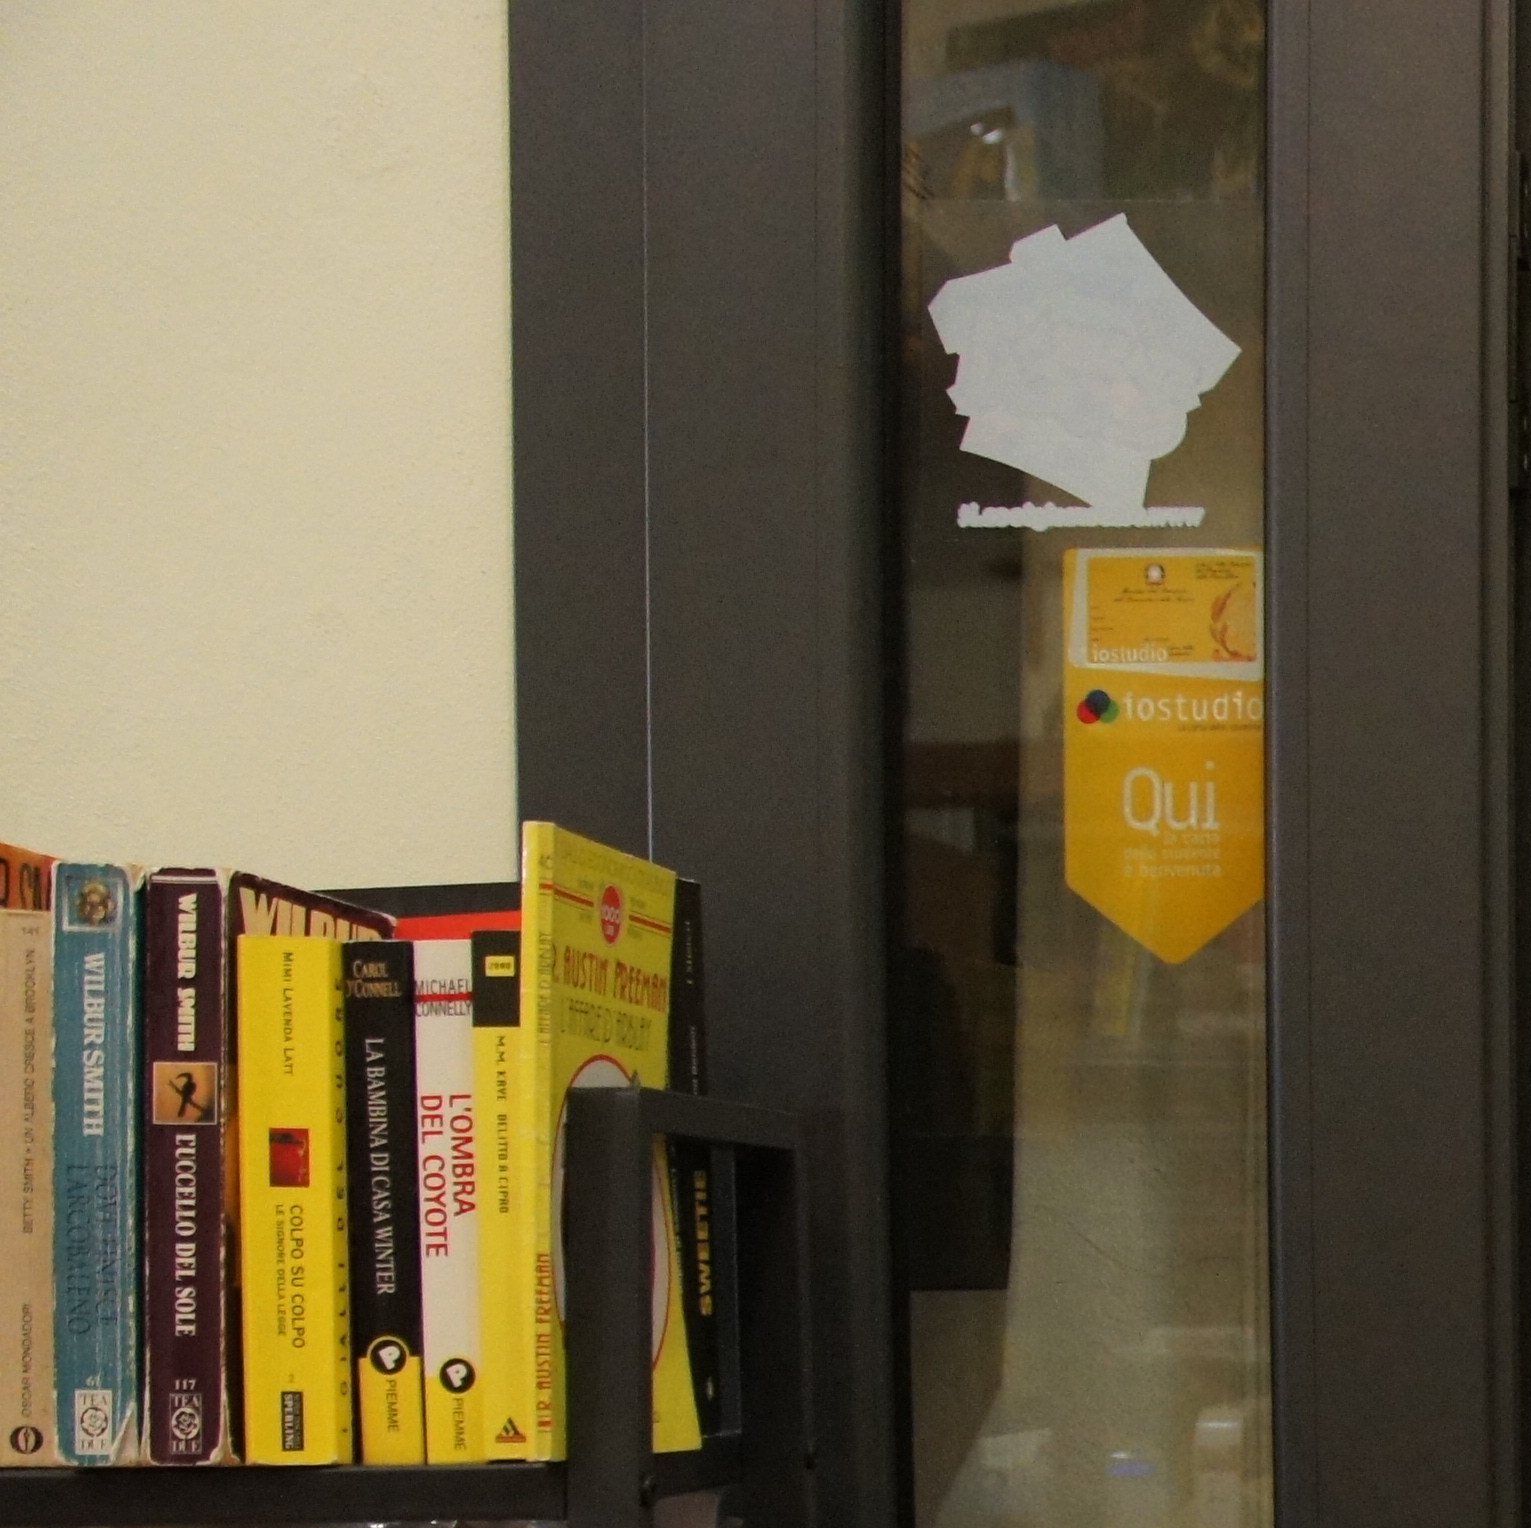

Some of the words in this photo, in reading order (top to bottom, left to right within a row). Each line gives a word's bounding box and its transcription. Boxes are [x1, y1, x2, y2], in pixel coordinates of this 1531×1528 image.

[1123, 691, 1264, 721] iostudio
[1124, 761, 1220, 836] Qui
[177, 892, 198, 980] WILBUR
[23, 949, 37, 1014] BROOKLYN
[281, 951, 295, 984] MIMI
[353, 959, 388, 979] CAROL
[414, 977, 471, 996] MICHAEL
[563, 944, 609, 997] AUSTIN
[613, 958, 668, 1014] FREEMAN
[83, 951, 105, 1045] WILBUR
[176, 986, 197, 1052] SMITH
[281, 987, 295, 1043] LAVENDA
[414, 1000, 472, 1017] CONNELLY
[23, 1029, 36, 1076] CRESCE
[282, 1046, 295, 1076] LATT
[364, 1037, 385, 1063] LA
[82, 1048, 105, 1136] SMITH
[366, 1066, 391, 1149] BAMBINA
[420, 1094, 444, 1145] DEL
[496, 1113, 509, 1162] DELITTO
[23, 1158, 36, 1194] SMITH
[370, 1152, 390, 1172] DI
[448, 1093, 477, 1218] L'OMBRA
[23, 1198, 36, 1235] BETTY
[371, 1174, 392, 1224] CASA
[422, 1154, 449, 1258] COYOTE
[498, 1176, 509, 1214] CIPRO
[289, 1203, 305, 1260] COLPO
[692, 1169, 714, 1317] SWEETIE
[174, 1243, 197, 1282] DEL
[276, 1269, 287, 1299] DELLA
[290, 1263, 305, 1289] SU
[373, 1225, 396, 1295] WINTER
[174, 1286, 197, 1338] SOLE
[535, 1252, 551, 1326] FREEMAN
[276, 1302, 288, 1337] LEGGE
[290, 1293, 306, 1349] COLPO
[174, 1379, 196, 1391] 117
[536, 1333, 552, 1391] AUSTIN
[21, 1377, 33, 1418] OSCAR
[284, 1393, 294, 1450] SPERLING
[385, 1378, 400, 1433] PIEMME
[452, 1397, 466, 1452] PIEMME
